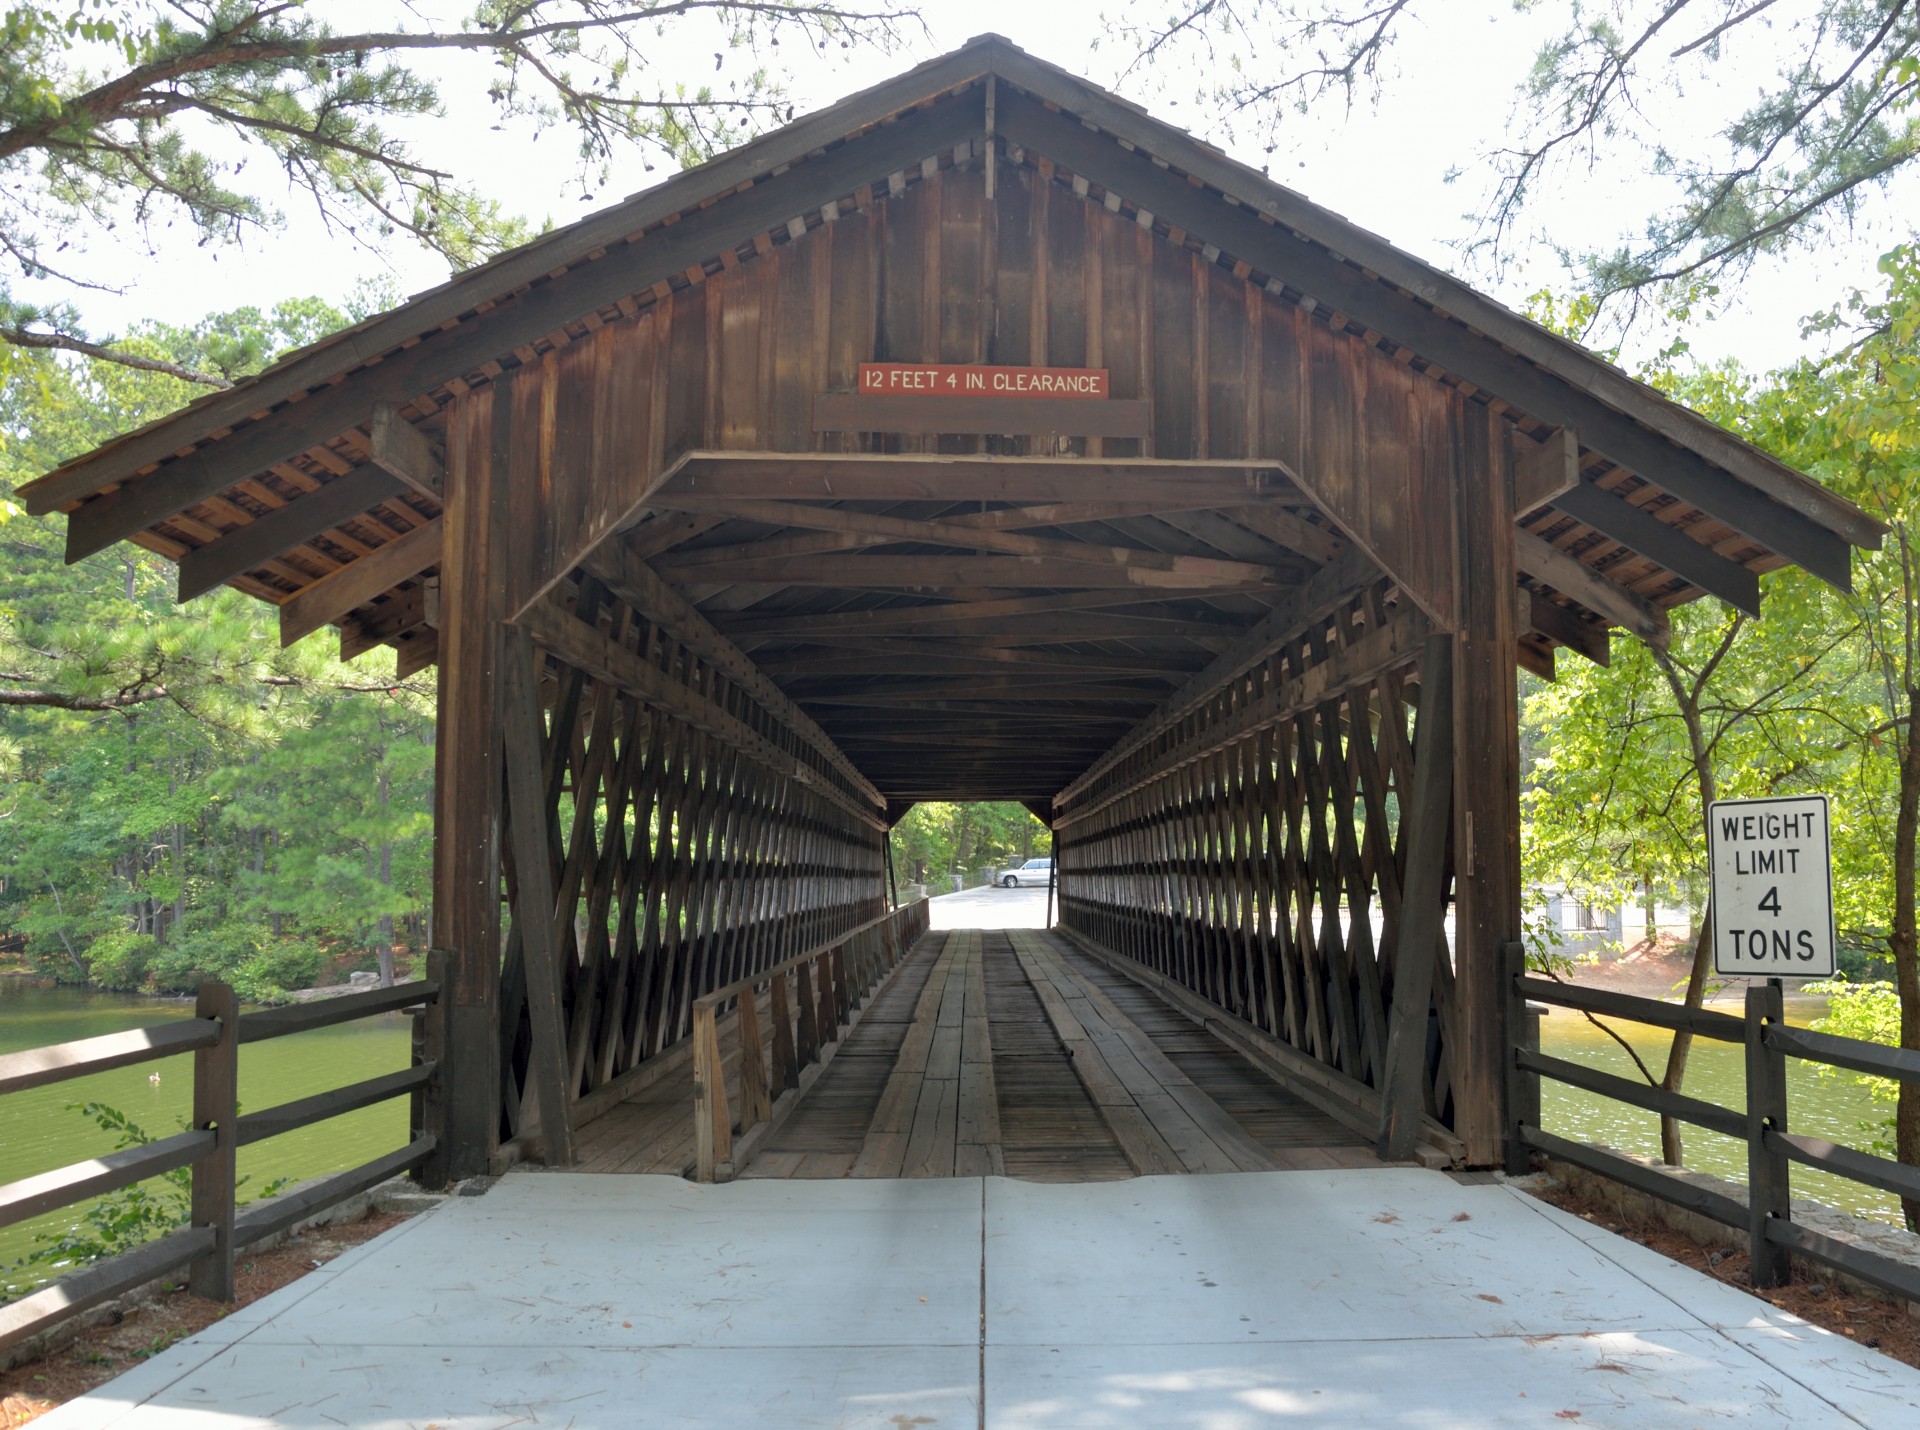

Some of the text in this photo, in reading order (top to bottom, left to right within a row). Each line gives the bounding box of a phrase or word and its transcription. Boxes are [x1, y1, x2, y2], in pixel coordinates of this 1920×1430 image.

[866, 370, 1101, 393] 12 FEET 4 IN. CLEARANCE
[1721, 812, 1815, 842] WEIGHT
[1735, 848, 1800, 876] LIMIT
[1757, 886, 1782, 918] 4
[1729, 929, 1815, 962] TONS
